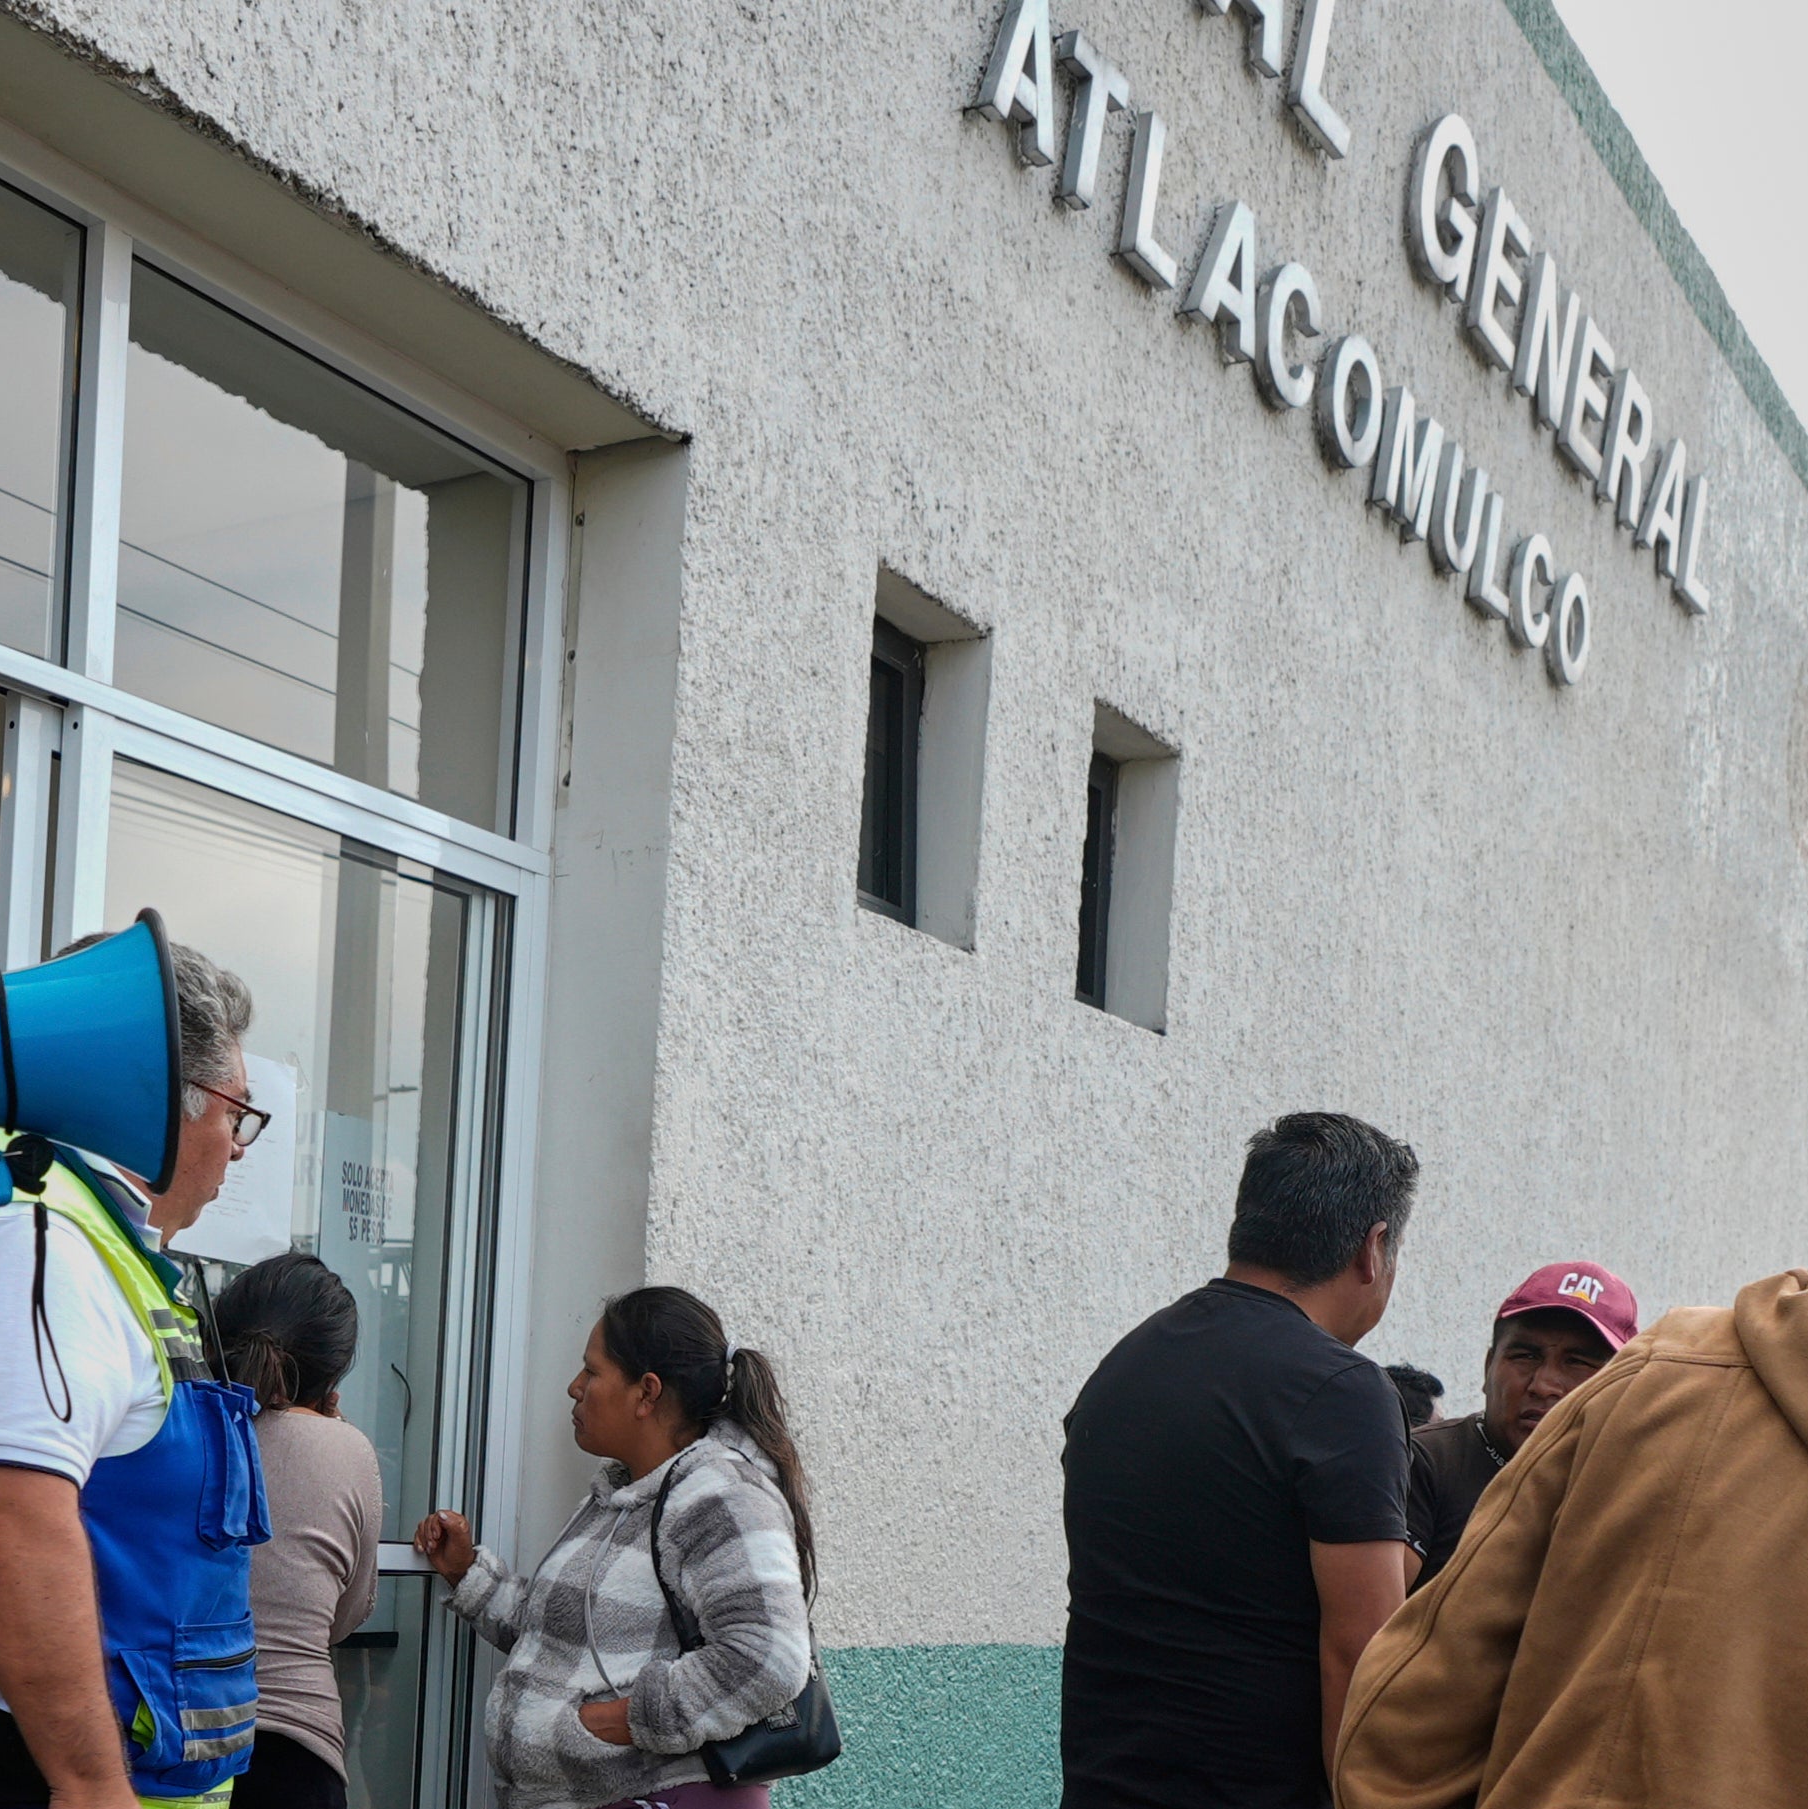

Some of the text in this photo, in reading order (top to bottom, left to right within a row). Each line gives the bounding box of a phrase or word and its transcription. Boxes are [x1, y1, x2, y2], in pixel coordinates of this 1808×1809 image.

[966, 0, 1590, 684] ATLACOMULCO
[1411, 114, 1708, 614] GENERAL
[342, 1160, 364, 1187] SOLO
[364, 1167, 395, 1195] ACEPTA
[342, 1188, 382, 1218] MONEDAS
[362, 1218, 386, 1245] PESOS
[1557, 1272, 1604, 1305] CAT
[1486, 1446, 1508, 1467] JUS
